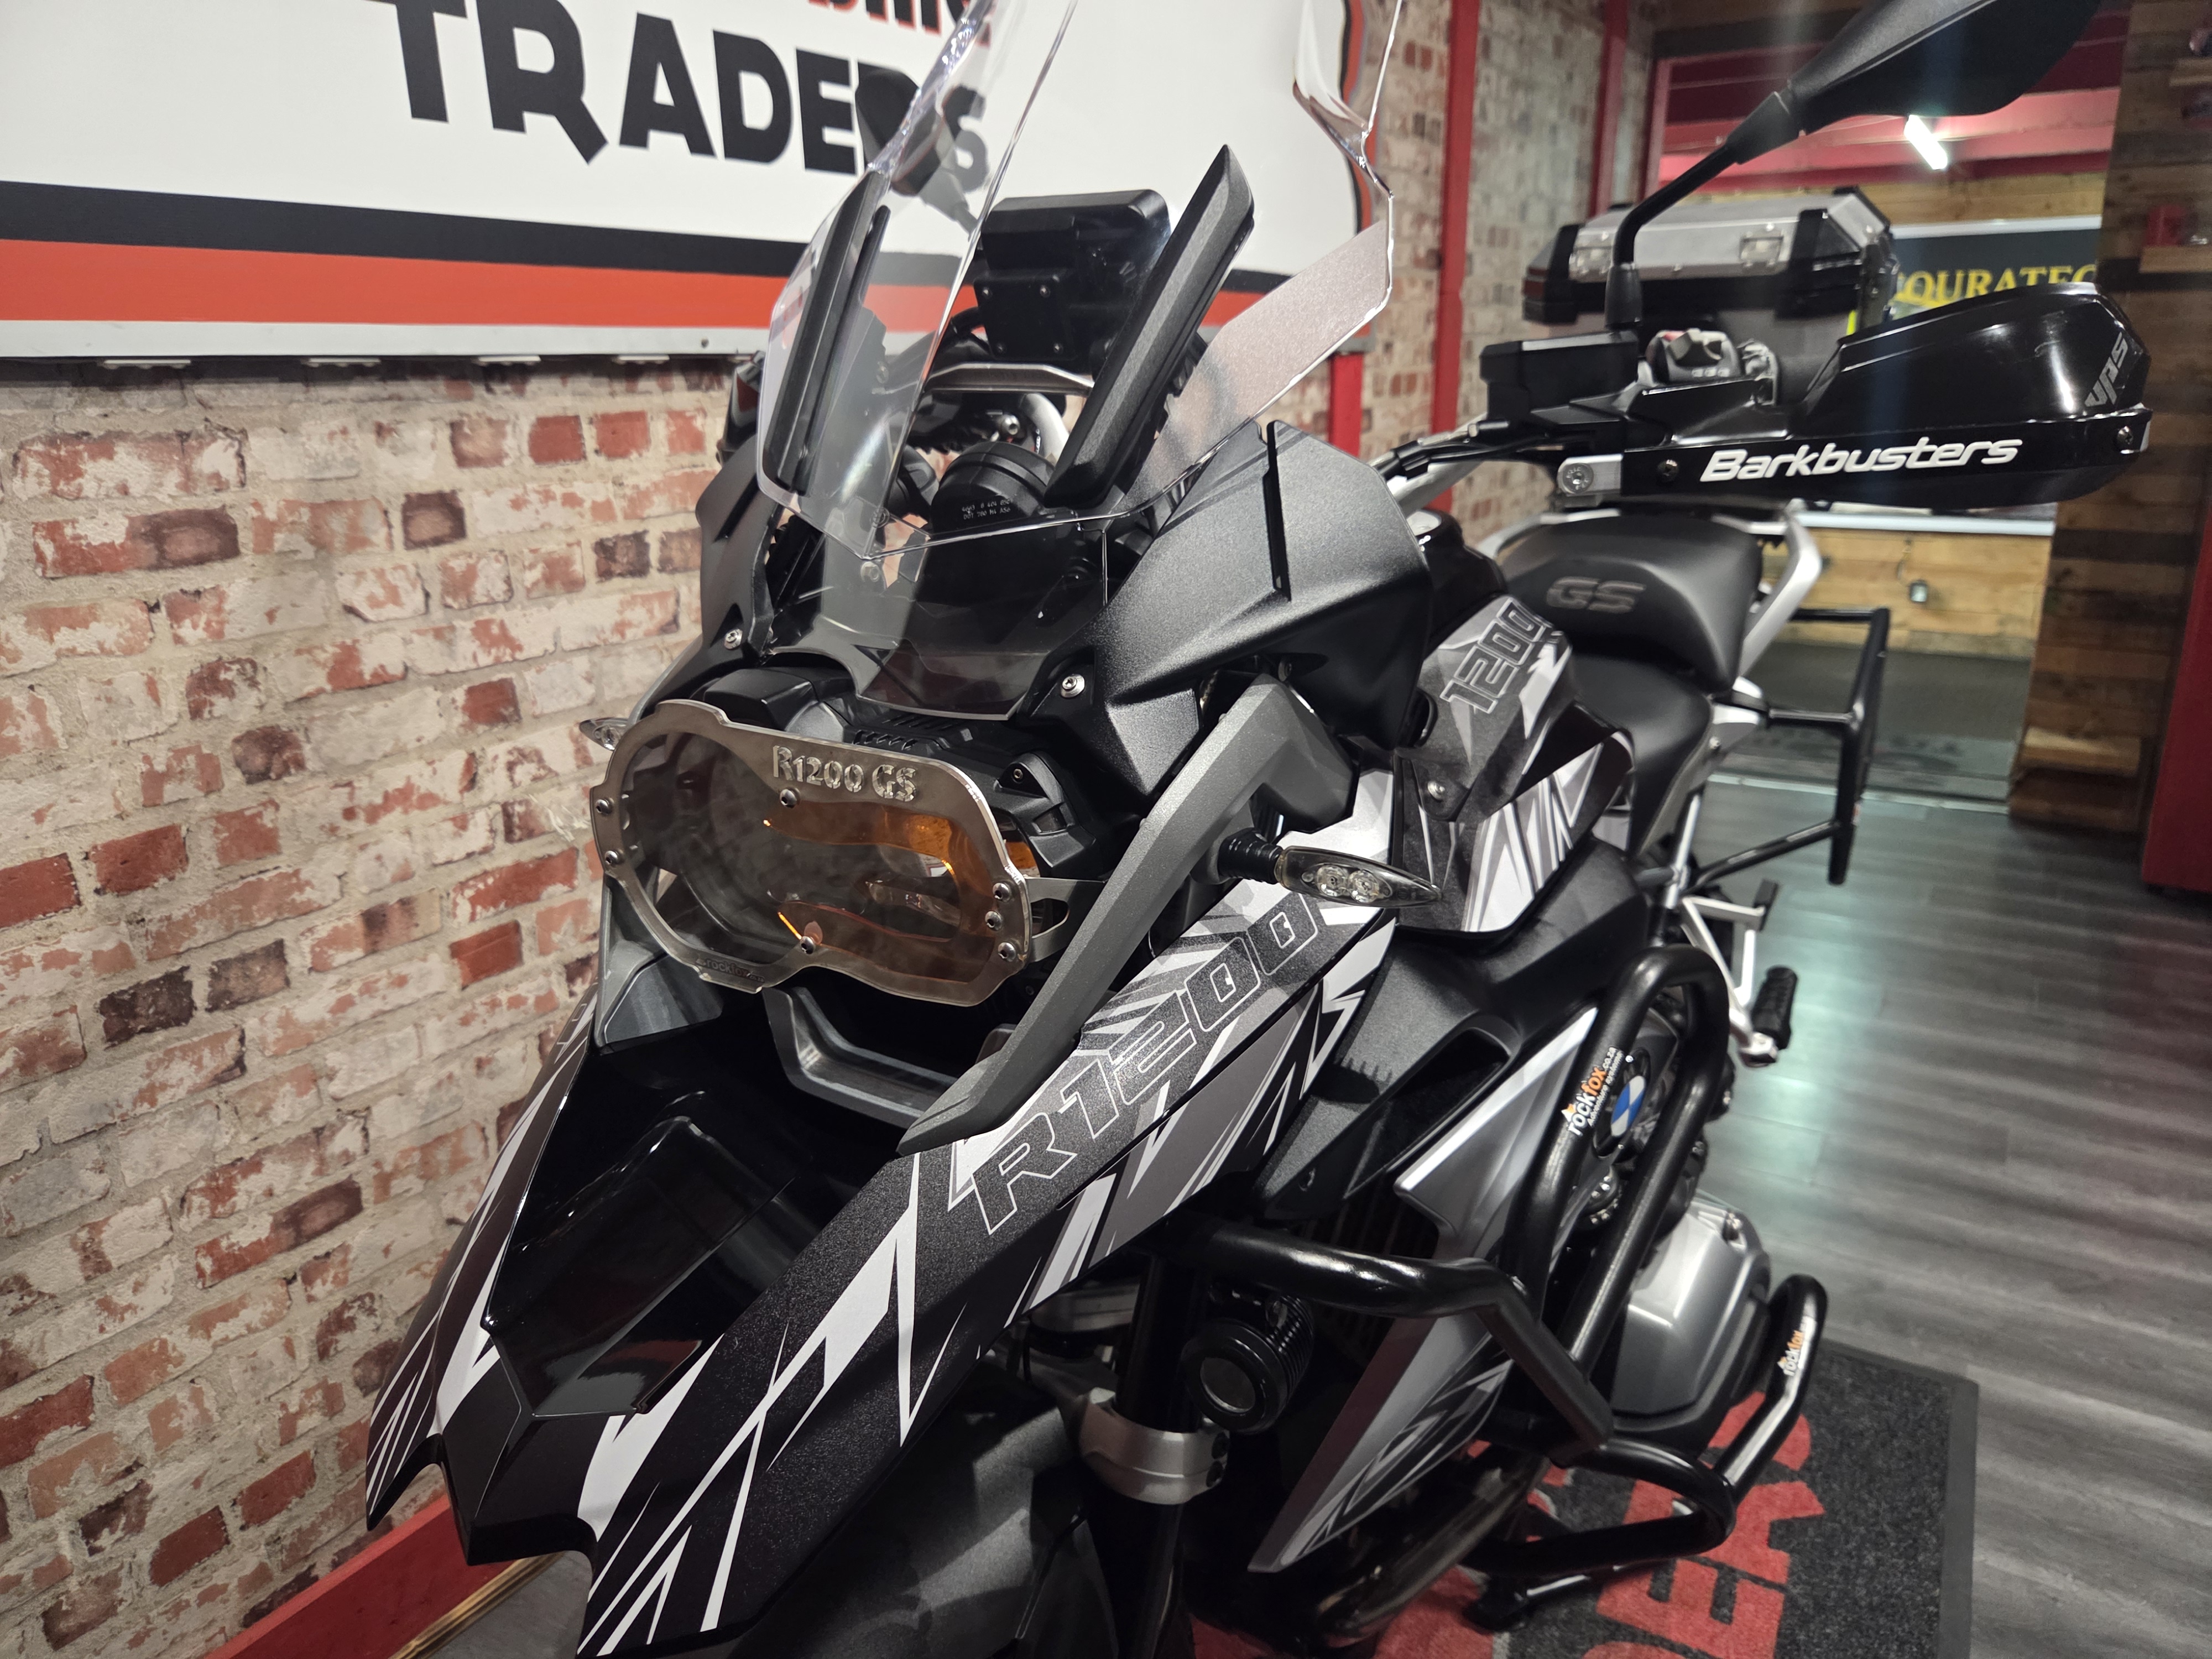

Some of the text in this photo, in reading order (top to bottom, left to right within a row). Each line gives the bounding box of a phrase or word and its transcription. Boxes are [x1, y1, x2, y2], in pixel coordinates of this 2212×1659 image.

[1898, 263, 2096, 306] OURATE
[1700, 436, 2023, 482] Barkbusters
[1546, 576, 1646, 614] GS
[1439, 597, 1547, 714] 1200
[773, 744, 916, 802] R1200 GS
[971, 891, 1318, 1235] R1200
